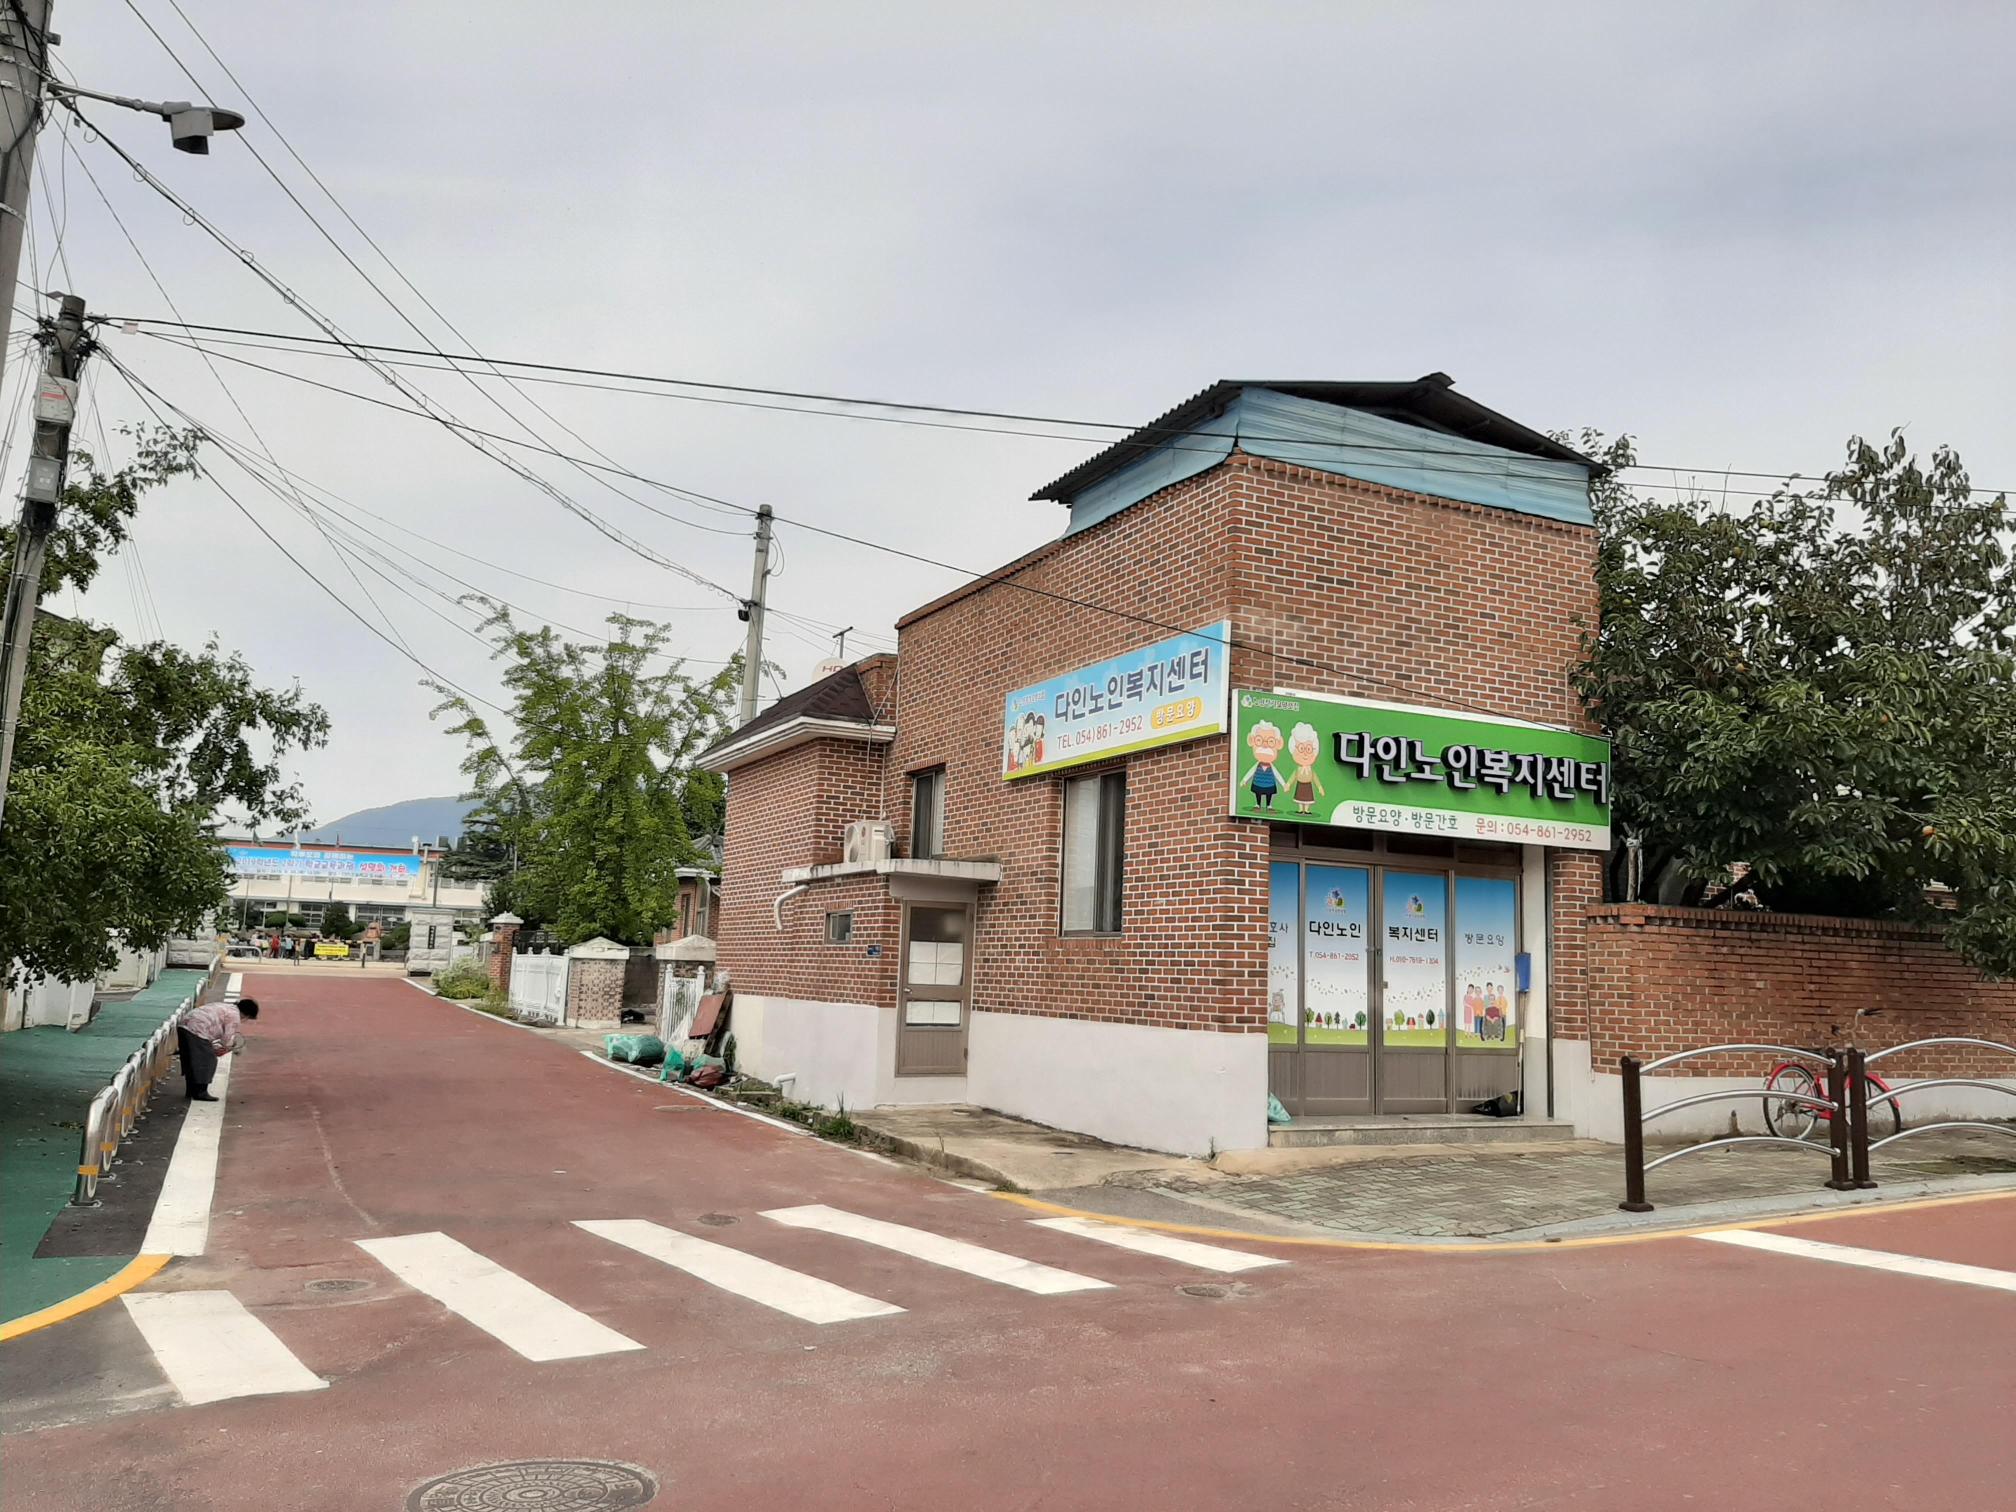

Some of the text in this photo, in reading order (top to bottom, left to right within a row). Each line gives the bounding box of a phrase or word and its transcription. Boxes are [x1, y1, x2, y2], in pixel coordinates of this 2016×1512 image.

[1054, 648, 1210, 722] 다인노인복지센터
[1155, 701, 1197, 726] 방문요양
[1332, 731, 1608, 804] 다인노인복지센터
[1309, 920, 1361, 938] 다인노인
[1388, 926, 1438, 943] 복지센터
[1465, 932, 1505, 947] 방문요양
